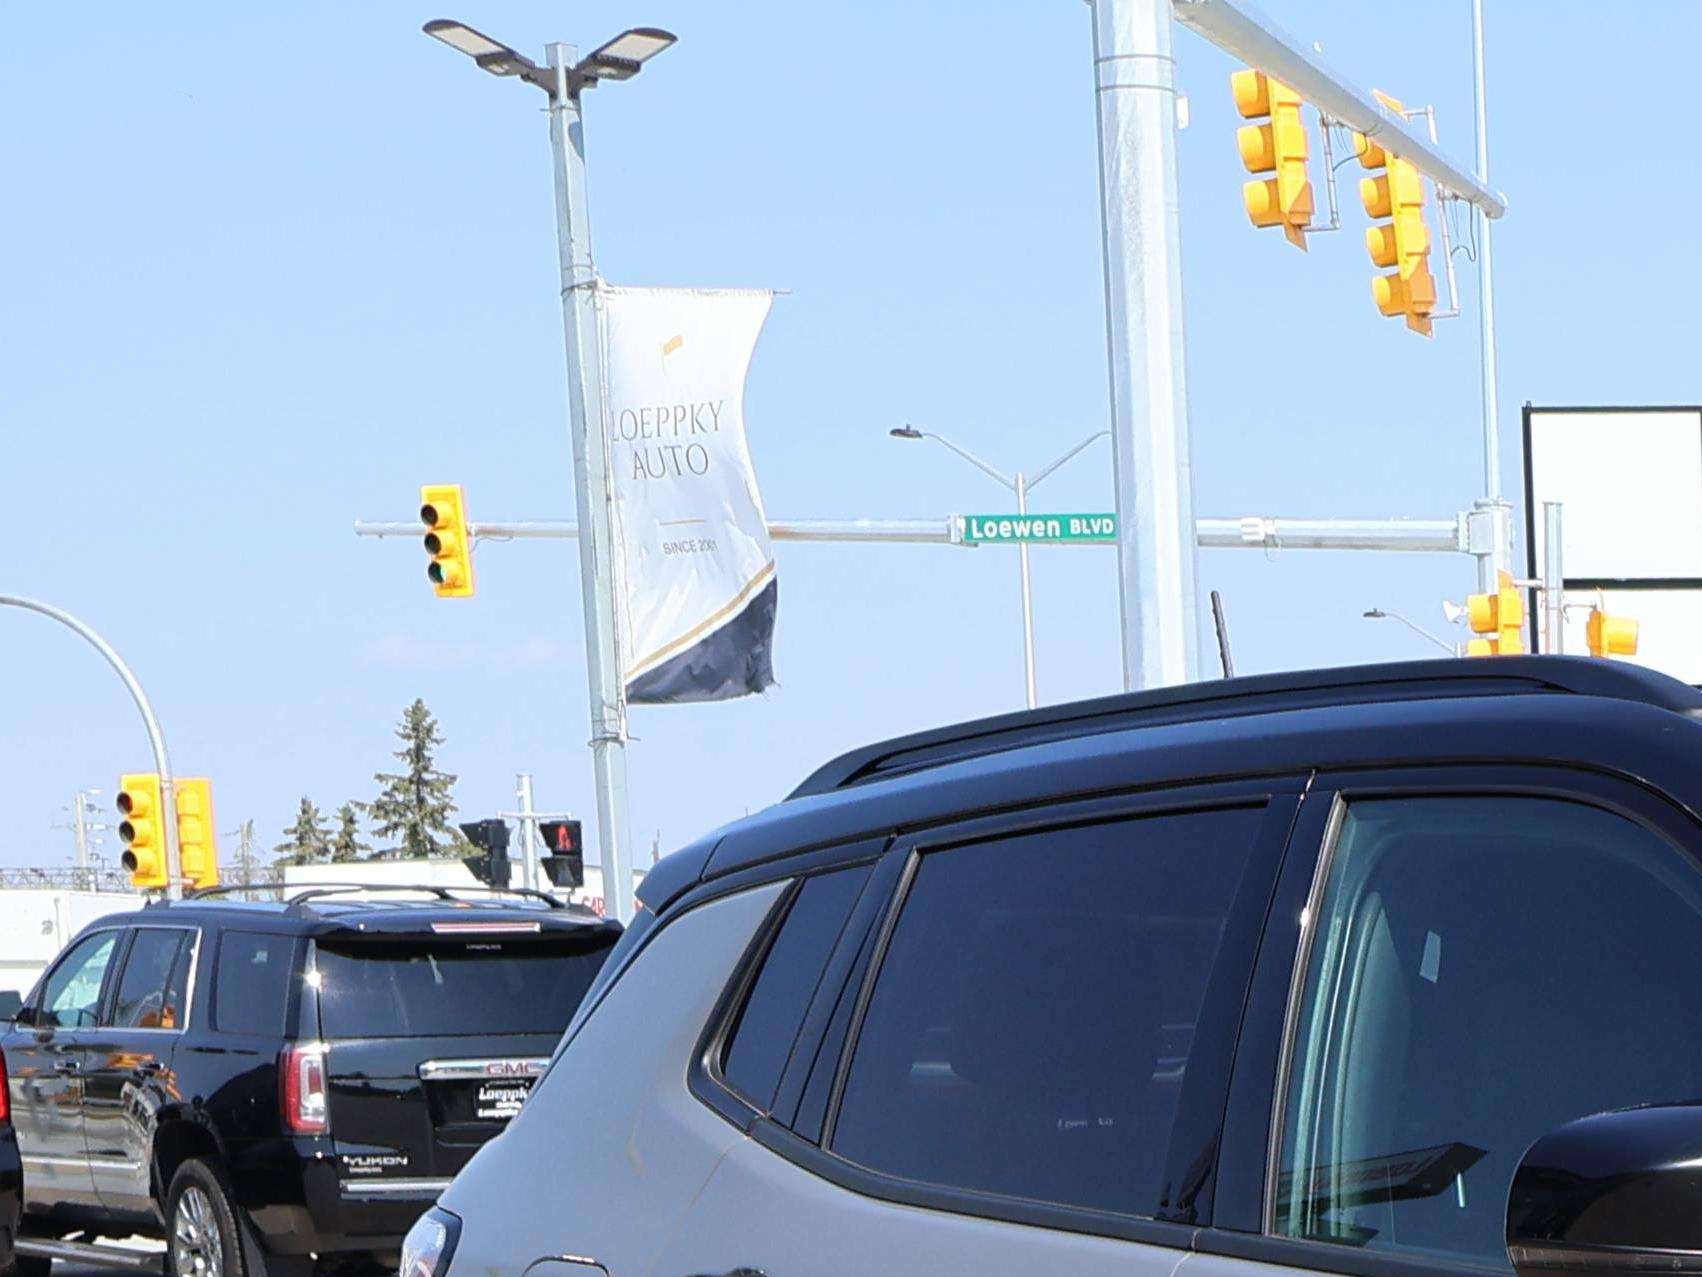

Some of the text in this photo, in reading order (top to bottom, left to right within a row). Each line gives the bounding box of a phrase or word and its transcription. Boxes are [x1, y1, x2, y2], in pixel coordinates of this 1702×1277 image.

[610, 400, 723, 442] LOEPPKY
[633, 443, 709, 480] AUTO
[971, 517, 1114, 539] Loewen BLVD
[662, 541, 697, 555] SINCE
[479, 1087, 529, 1102] Loeppk
